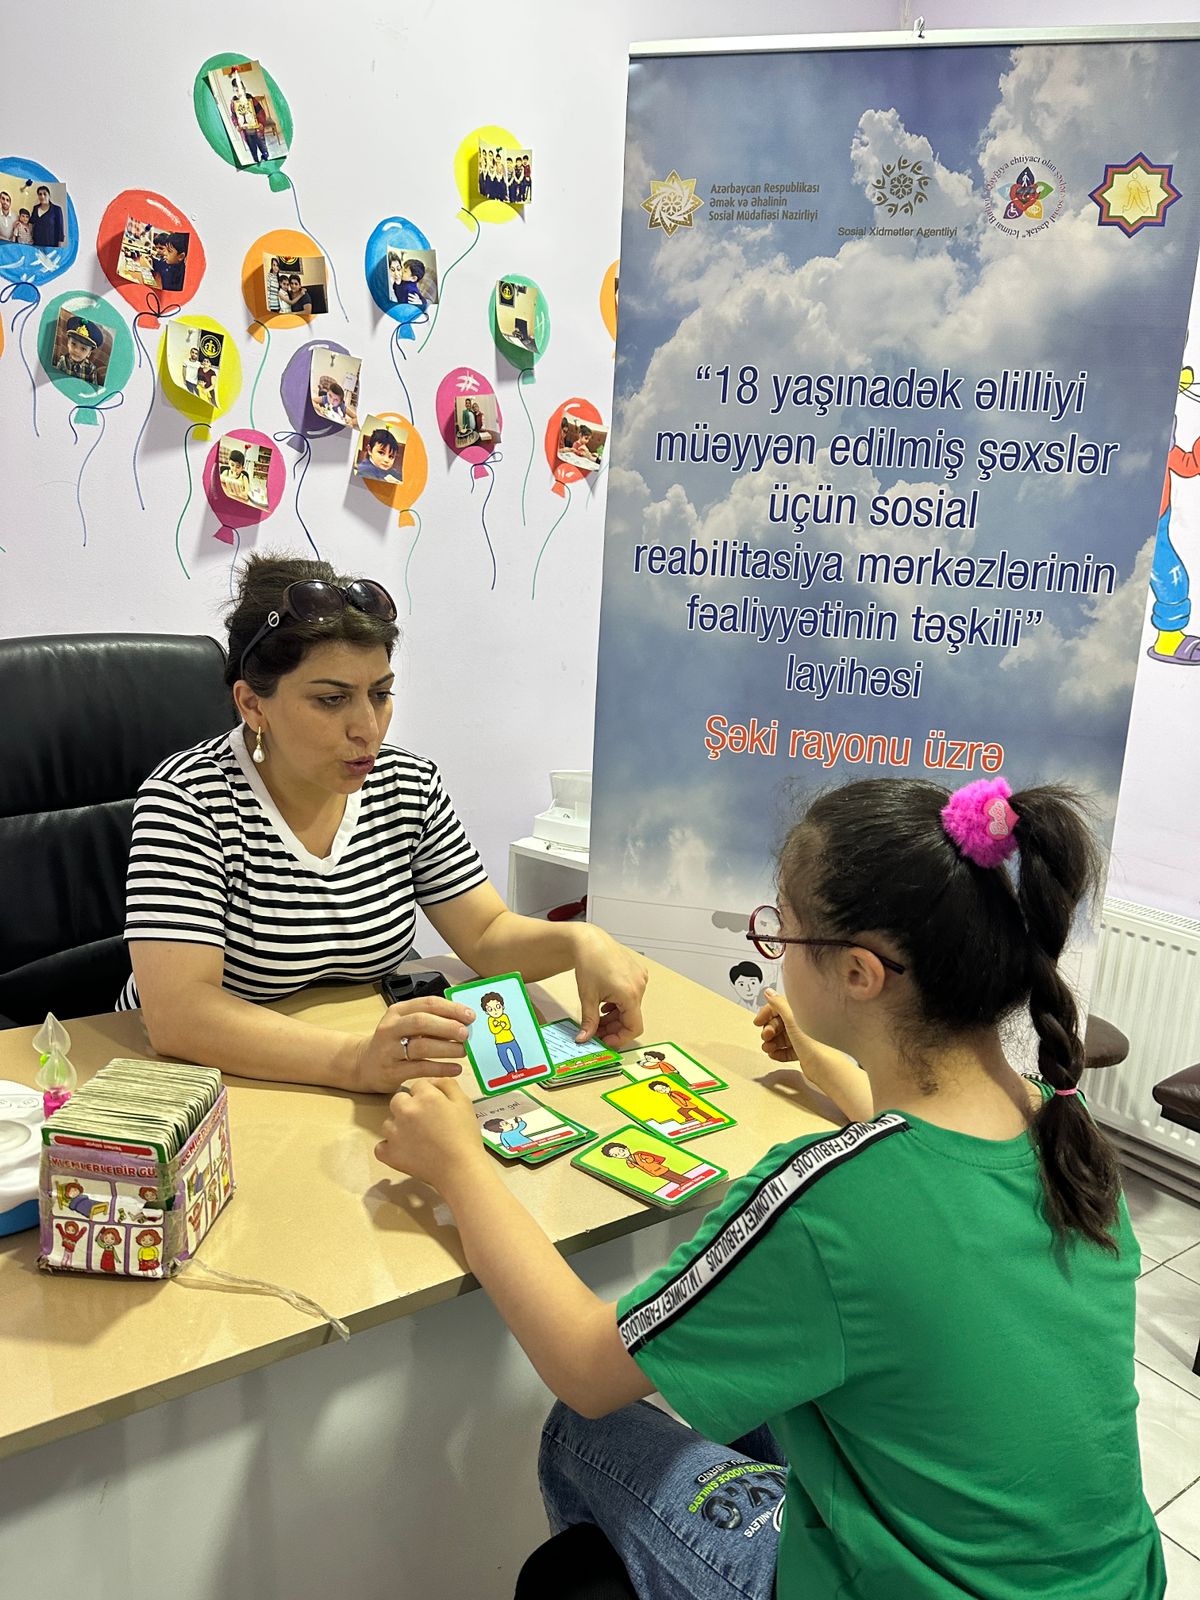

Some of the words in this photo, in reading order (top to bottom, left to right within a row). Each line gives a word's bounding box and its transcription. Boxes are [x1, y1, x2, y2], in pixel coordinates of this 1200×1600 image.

[1041, 159, 1057, 172] olan
[709, 197, 735, 207] Əmək
[738, 199, 748, 207] və
[751, 196, 788, 207] Əhalinin
[710, 183, 761, 196] Azərbaycan
[763, 182, 820, 195] Respublikası
[709, 210, 734, 221] Sosial
[736, 210, 780, 221] Müdafiəsi
[782, 209, 818, 222] Nazirliyi
[838, 227, 866, 236] Sosial
[869, 226, 914, 236] Xidmətlər
[916, 226, 958, 238] Agentliyi
[696, 366, 759, 404] “18
[770, 368, 964, 415] yaşınadək
[975, 369, 1087, 421] əlilliyi
[655, 423, 816, 472] müəyyən
[829, 427, 966, 479] edilmiş
[977, 434, 1119, 480] şəxslər
[768, 484, 857, 532] üçün
[869, 489, 979, 529] sosial
[633, 540, 844, 588] reabilitasiya
[857, 548, 1117, 595] mərkəzlərinin
[686, 595, 898, 643] fəaliyyətinin
[911, 604, 1043, 653] təşkili”
[785, 654, 923, 699] layihəsi
[704, 714, 777, 760] Şəki
[788, 726, 911, 768] rayonu
[923, 730, 1005, 772] üzrə
[139, 1165, 158, 1178] GÜ
[791, 1139, 844, 1178] FABULOUS
[741, 1188, 775, 1235] LOWKEY
[705, 1221, 746, 1272] FABULOUS
[661, 1275, 692, 1317] LOWKEY
[620, 1300, 662, 1345] FABULOUS
